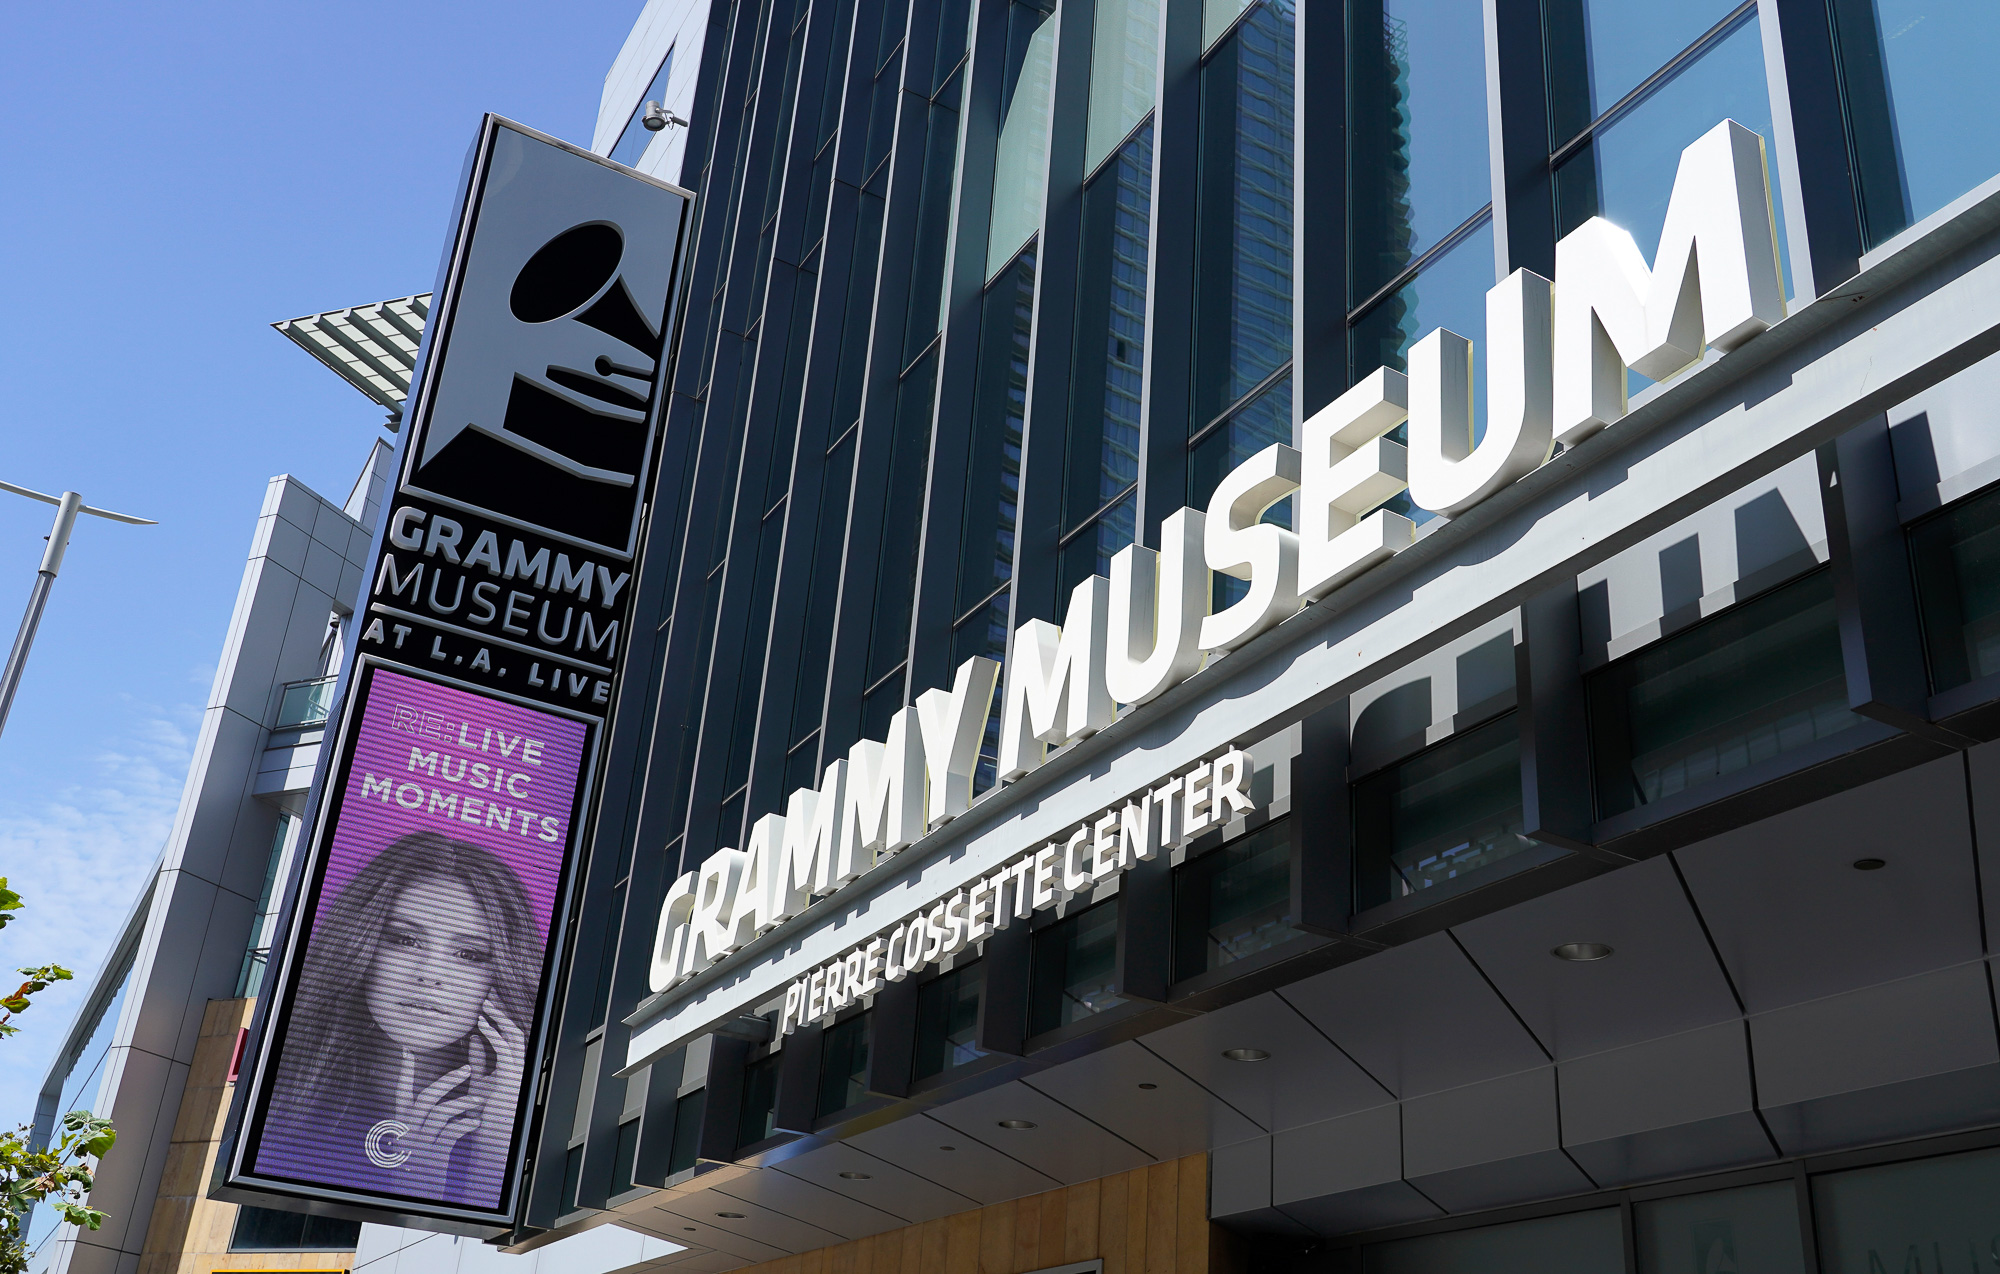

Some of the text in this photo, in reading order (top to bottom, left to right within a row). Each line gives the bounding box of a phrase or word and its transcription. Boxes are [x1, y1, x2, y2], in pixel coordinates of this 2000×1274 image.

[389, 506, 631, 610] GRAMMY
[648, 117, 1786, 993] GRAMMY MUSEUM
[374, 553, 619, 661] MUSEUM
[362, 618, 611, 705] AT L.A. LIVE
[391, 703, 546, 767] RE:LIVE
[407, 746, 532, 799] MUSIC
[360, 772, 561, 843] MOMENTS
[782, 749, 1257, 1036] PIERRE COSSETTE CENTER
